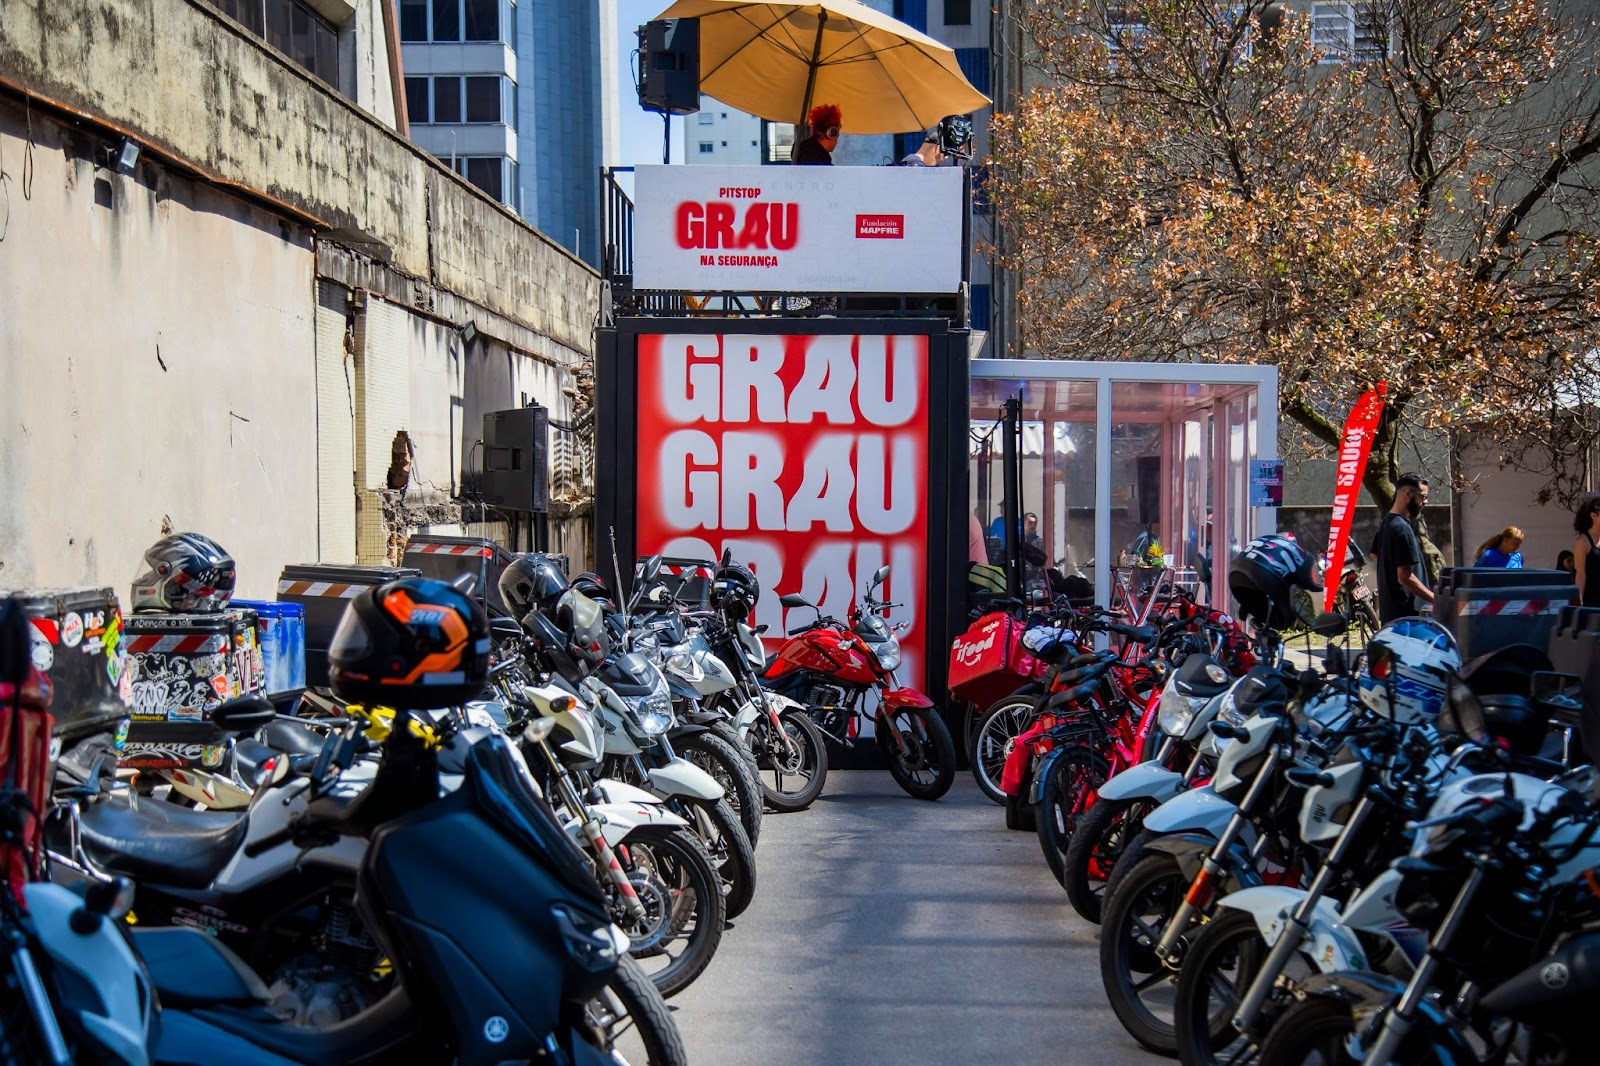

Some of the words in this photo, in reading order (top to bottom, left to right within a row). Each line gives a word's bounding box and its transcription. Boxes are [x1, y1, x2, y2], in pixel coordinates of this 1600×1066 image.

[719, 187, 762, 199] PITSTOP
[674, 200, 800, 251] GRAU
[859, 226, 900, 236] MAPFRE
[861, 218, 898, 228] Fundación
[700, 255, 715, 267] NA
[717, 255, 779, 269] SEGURANÇA
[660, 334, 917, 427] GRAU
[660, 429, 916, 534] GRAU
[1332, 493, 1349, 521] NA
[956, 631, 996, 662] ifood
